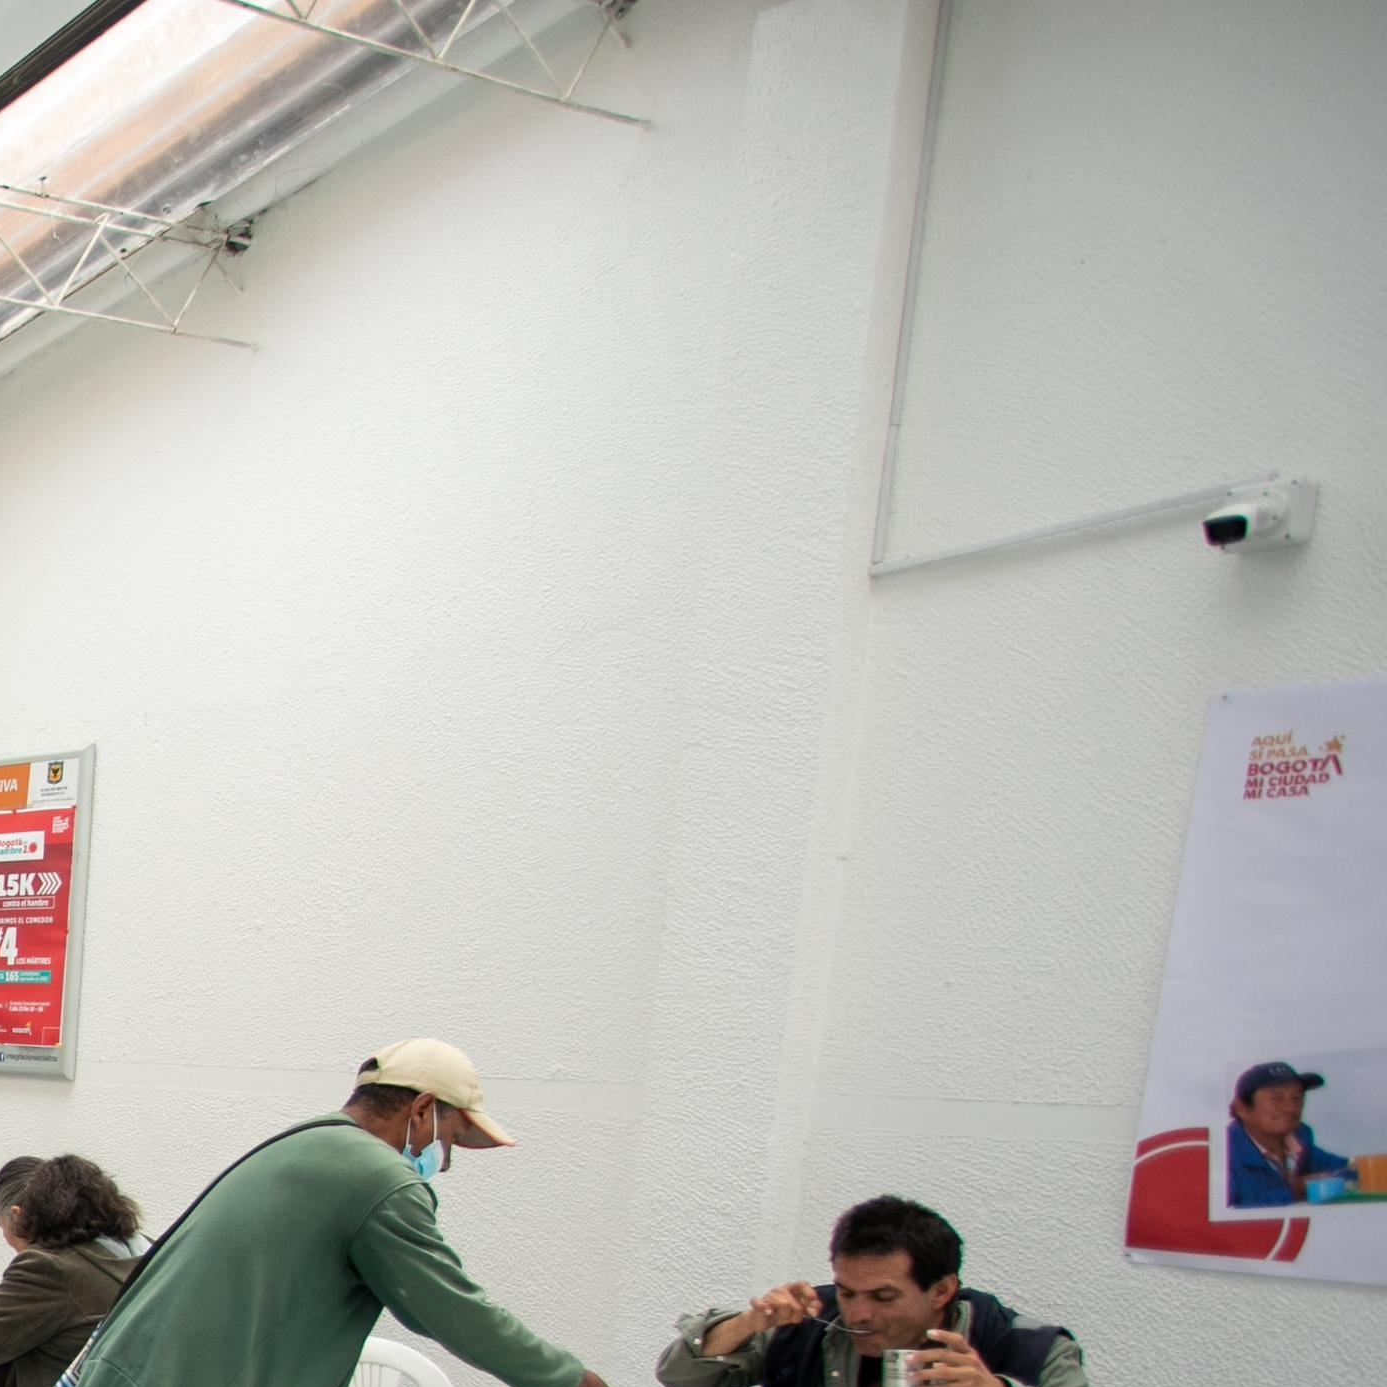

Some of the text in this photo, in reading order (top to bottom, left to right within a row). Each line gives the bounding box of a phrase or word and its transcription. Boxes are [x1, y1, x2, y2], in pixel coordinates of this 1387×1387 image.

[1245, 773, 1330, 788] MI CIUDAD
[1243, 786, 1309, 800] MI CASA
